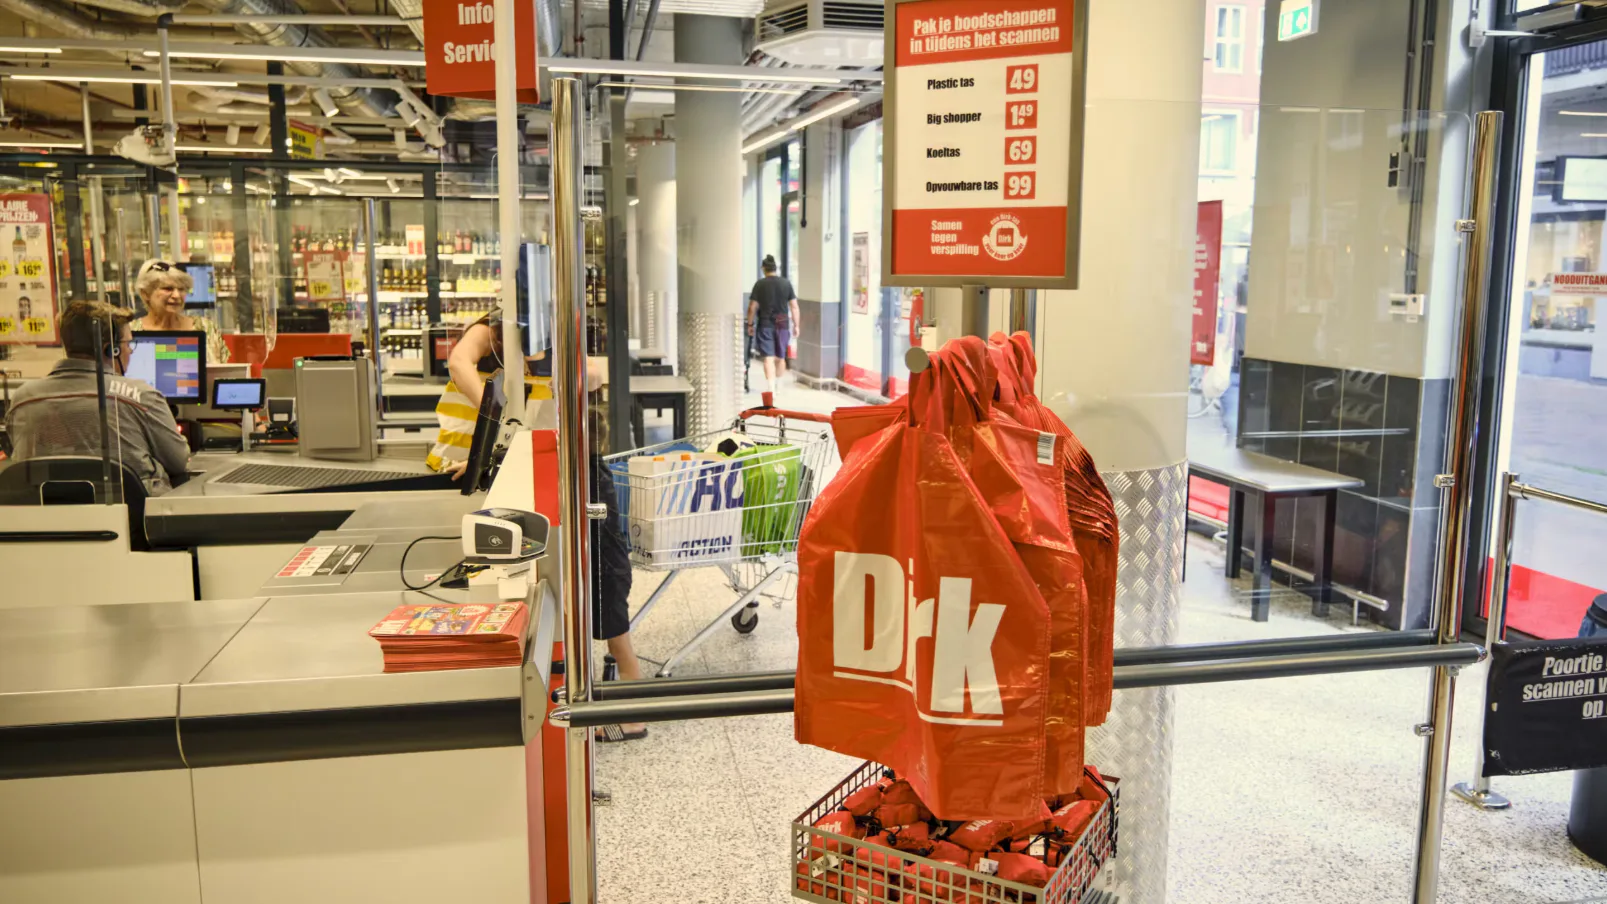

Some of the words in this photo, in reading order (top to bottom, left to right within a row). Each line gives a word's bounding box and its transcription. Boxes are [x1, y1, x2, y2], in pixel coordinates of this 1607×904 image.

[458, 2, 494, 25] Info
[914, 19, 937, 35] Pak
[938, 17, 951, 33] je
[955, 8, 1056, 30] boodschappen
[910, 38, 922, 54] in
[925, 34, 971, 51] tijdens
[974, 31, 997, 47] het
[999, 27, 1059, 45] scannen
[443, 40, 497, 64] Servic
[927, 78, 958, 90] Plastic
[960, 77, 974, 87] tas
[1010, 68, 1035, 90] 49
[927, 113, 941, 125] Big
[943, 112, 981, 123] shopper
[926, 147, 961, 158] Koeltas
[1009, 140, 1033, 161] 69
[926, 181, 982, 193] Opvouwbare
[983, 180, 998, 190] tas
[1008, 175, 1031, 196] 99
[931, 220, 962, 231] Samen
[931, 233, 957, 244] tegen
[931, 244, 979, 256] verspilling
[1554, 275, 1607, 285] NOODUITGAN
[109, 380, 141, 403] Dirk
[833, 551, 1007, 715] Drk
[1542, 653, 1603, 677] Poortje
[1522, 678, 1595, 701] scannen
[1582, 699, 1604, 719] op
